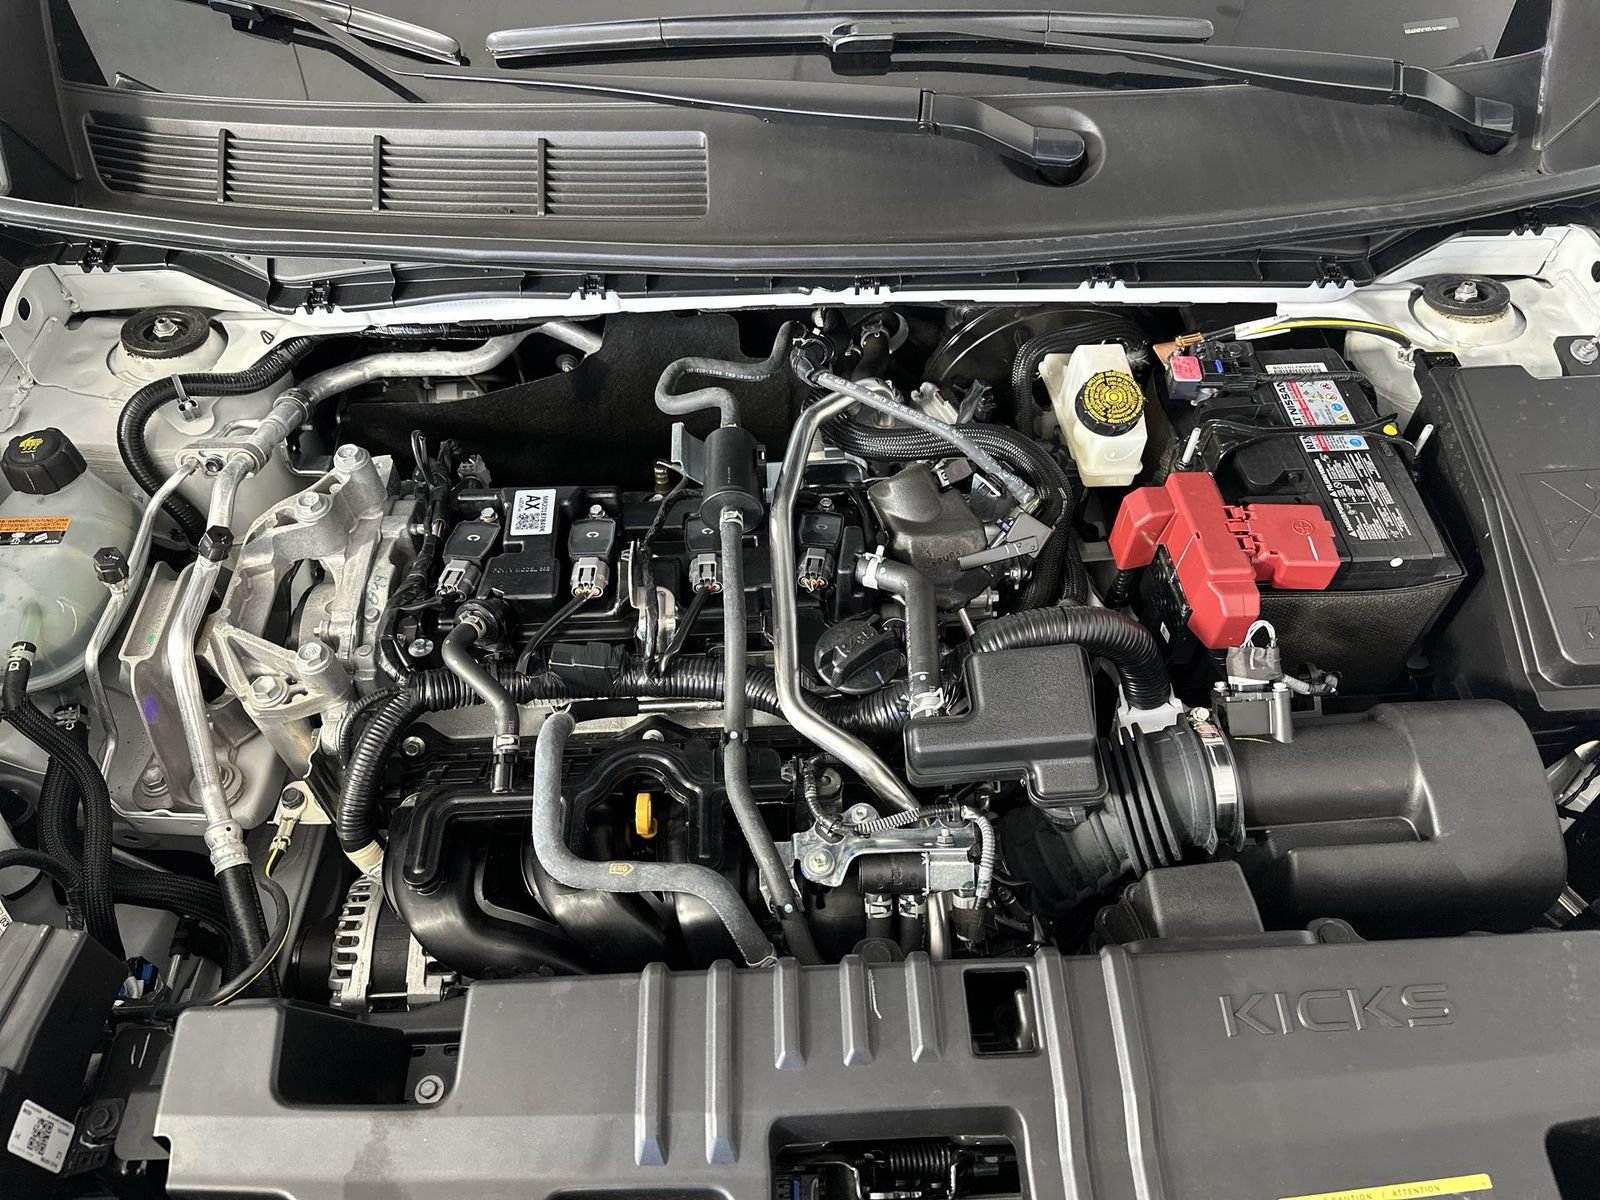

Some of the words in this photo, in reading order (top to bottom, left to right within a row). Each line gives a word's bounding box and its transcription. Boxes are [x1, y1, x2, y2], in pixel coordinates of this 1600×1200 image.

[524, 495, 541, 511] AX
[1218, 982, 1457, 1037] KICKS
[1392, 1184, 1441, 1197] ATTENTION
